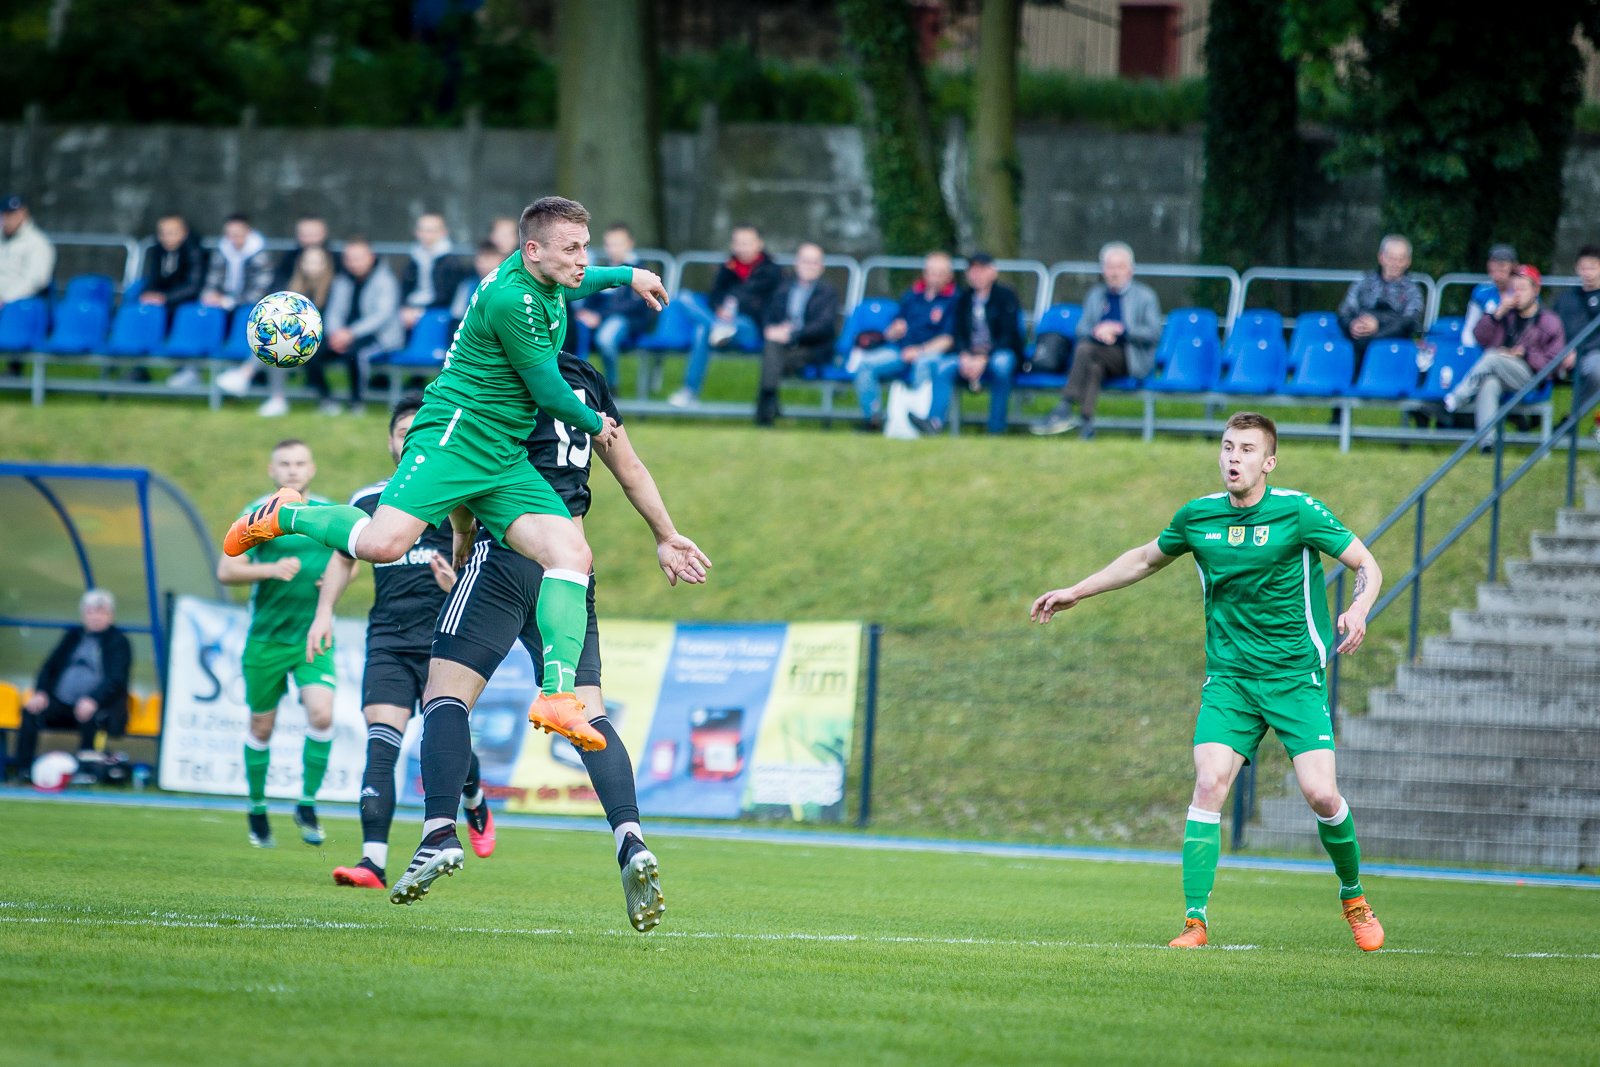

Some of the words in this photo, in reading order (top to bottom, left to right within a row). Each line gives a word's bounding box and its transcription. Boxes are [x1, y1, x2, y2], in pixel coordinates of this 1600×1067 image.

[1204, 532, 1222, 540] JAKO
[408, 546, 438, 566] GÓR
[789, 664, 848, 693] firm
